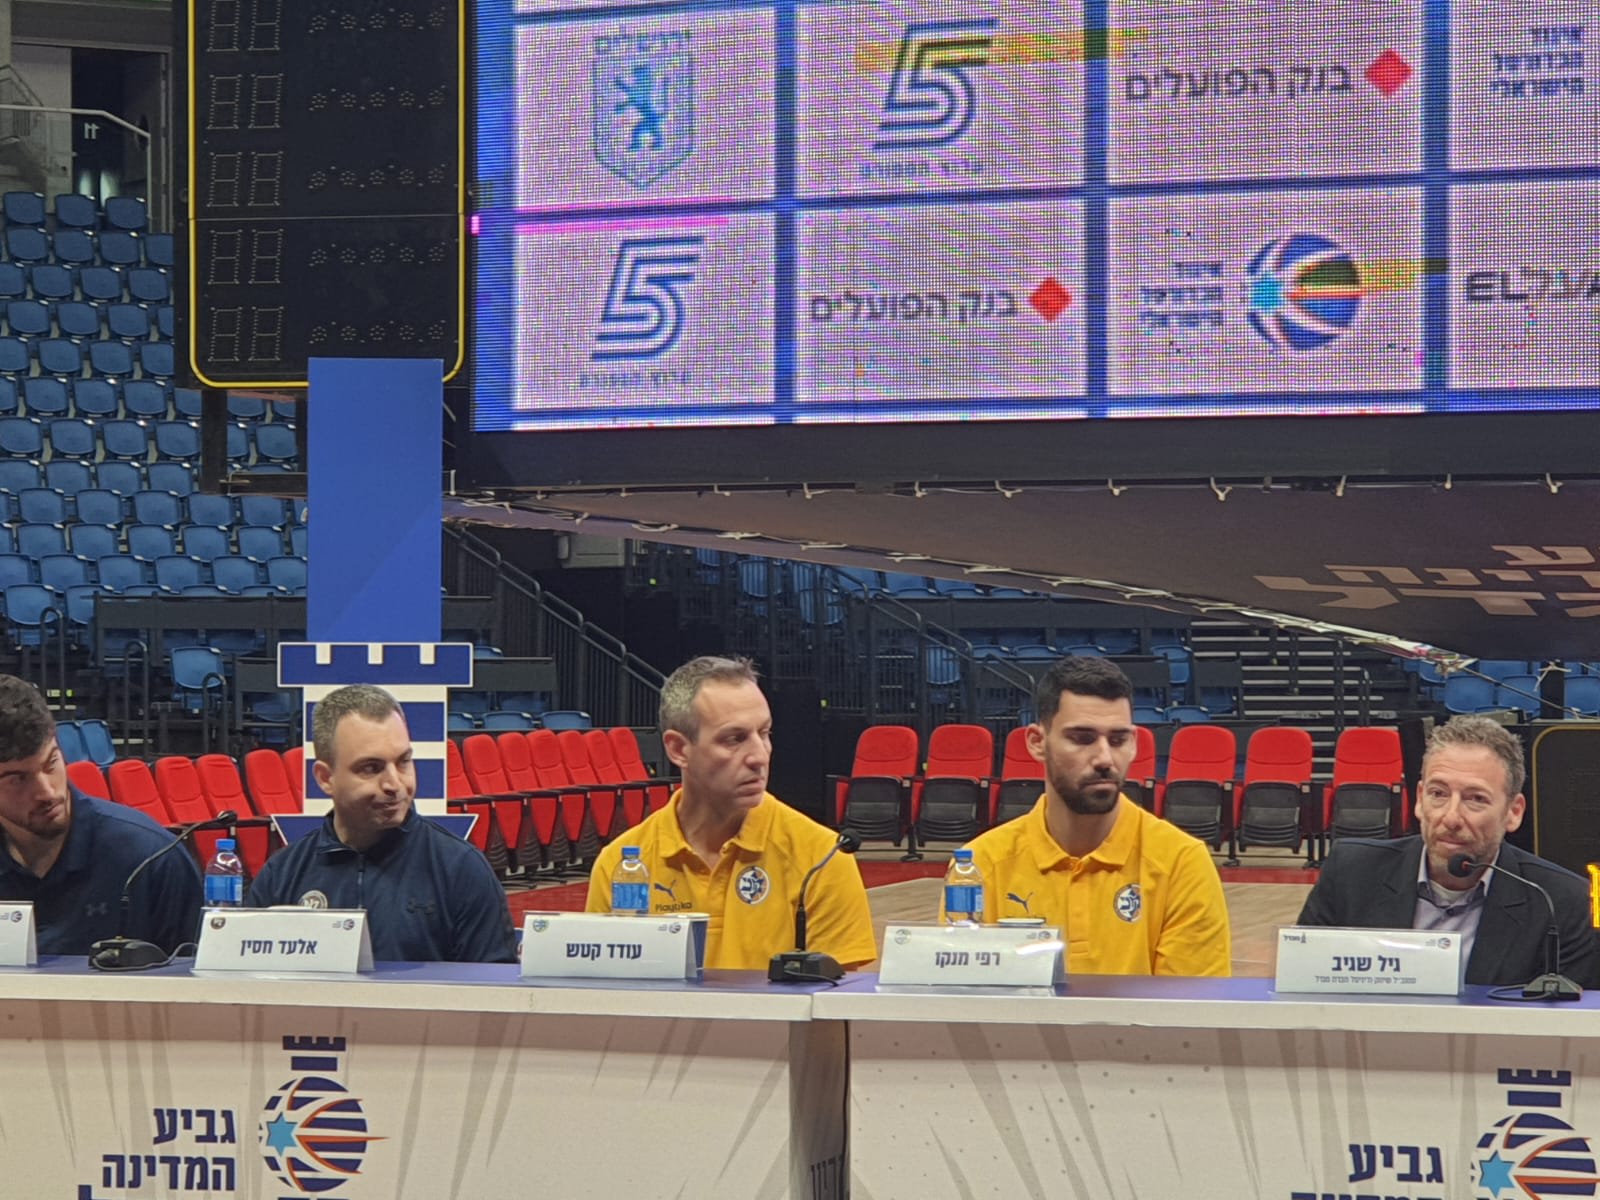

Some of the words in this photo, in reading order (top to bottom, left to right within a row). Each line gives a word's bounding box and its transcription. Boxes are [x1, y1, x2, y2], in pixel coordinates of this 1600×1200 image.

[1124, 65, 1276, 101] הפועלים
[1288, 64, 1352, 99] בנק
[809, 291, 949, 322] הפועלים
[957, 290, 1019, 323] בנק
[240, 939, 274, 956] חסין
[278, 938, 318, 955] אלעד
[566, 943, 602, 961] קטש
[606, 943, 643, 960] עודד
[975, 951, 1001, 966] רפי
[935, 951, 969, 968] מנקו
[1377, 954, 1401, 972] גיל
[153, 1108, 236, 1145] גביע
[102, 1154, 235, 1191] המדינה
[1348, 1144, 1444, 1183] גביע
